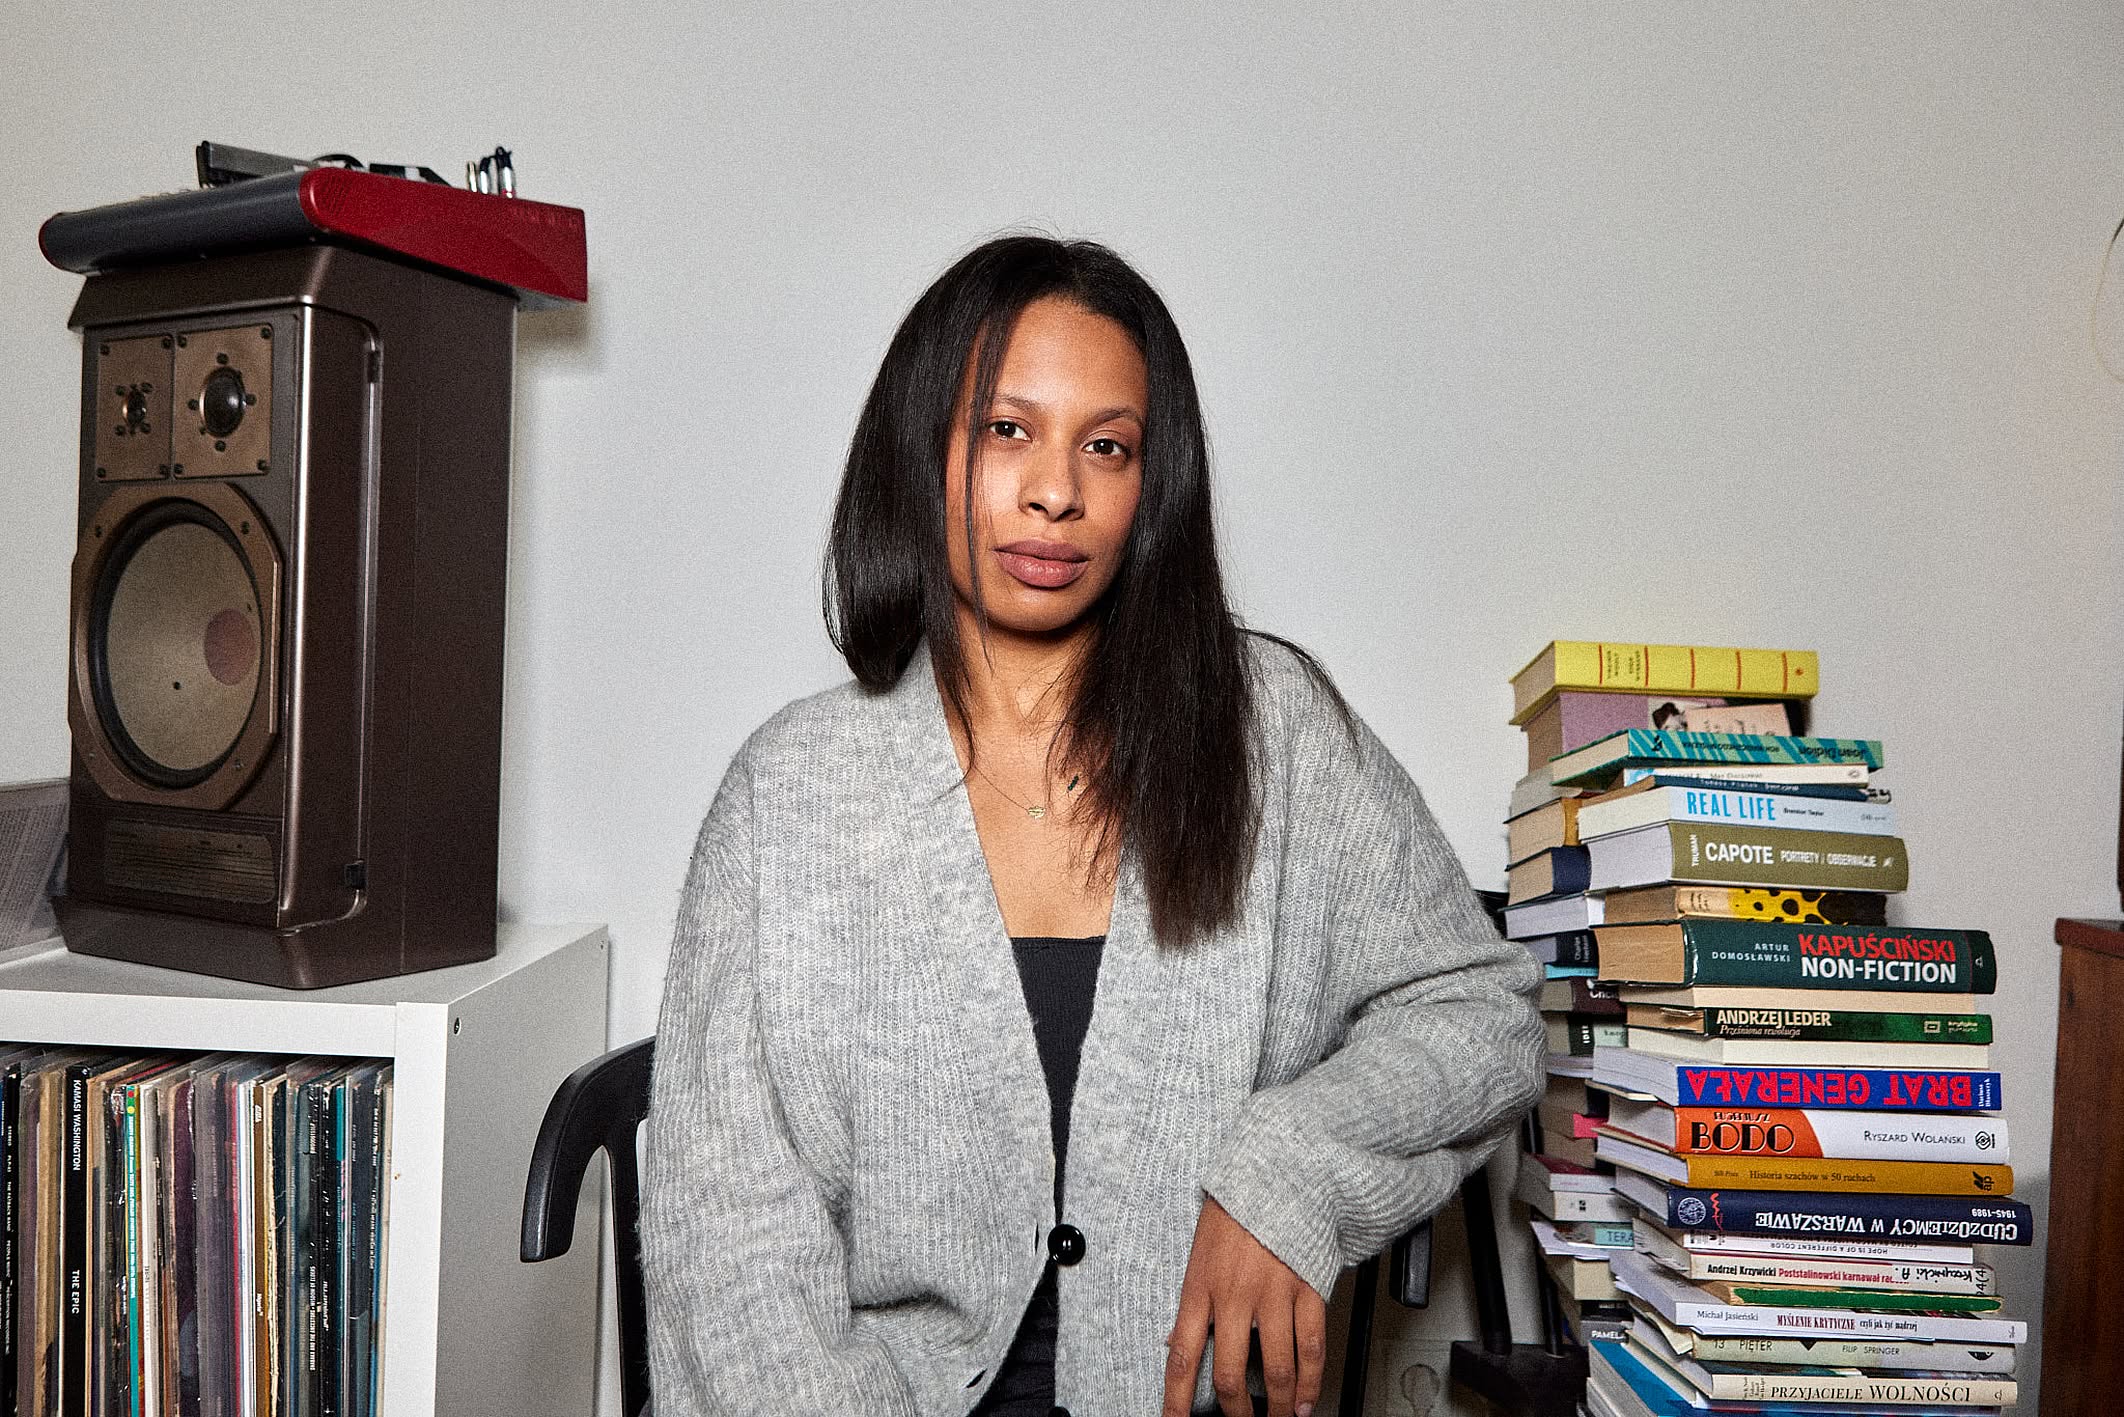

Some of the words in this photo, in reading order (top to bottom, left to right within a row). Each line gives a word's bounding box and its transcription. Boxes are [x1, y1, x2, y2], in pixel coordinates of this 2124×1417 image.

[1686, 791, 1731, 816] REAL
[1739, 796, 1777, 821] LIFE
[1689, 834, 1699, 867] TRUMAN
[1705, 841, 1774, 865] CAPOTE
[1711, 951, 1791, 964] DOMOSŁAWSKI
[1754, 943, 1790, 953] ARTUR
[1798, 933, 1956, 963] KAPUŚCIŃSKI
[1801, 957, 1957, 984] NON-FICTION
[1716, 1010, 1782, 1028] ANDRZEJ
[1784, 1011, 1832, 1027] LEDER
[72, 1079, 82, 1112] KAMASI
[1685, 1069, 1871, 1105] GENERAŁA
[1883, 1073, 1973, 1107] BRAT
[71, 1113, 82, 1171] WASHINGTON
[1690, 1121, 1796, 1153] BODO
[1749, 1170, 1783, 1181] Historia
[1784, 1171, 1820, 1182] szachów
[1821, 1174, 1829, 1182] w
[1831, 1172, 1842, 1182] 50
[1843, 1172, 1877, 1183] ruchach
[1755, 1211, 1866, 1233] WARSZAWIE
[1889, 1219, 2018, 1242] CUDZOZIEMCY
[1846, 1246, 1856, 1254] OF
[1867, 1247, 1888, 1256] HOPE
[70, 1269, 80, 1289] THE
[1707, 1263, 1737, 1276] Andrzej
[1739, 1265, 1777, 1279] Krzywicki
[1778, 1269, 1842, 1283] Poststalinowski
[1842, 1272, 1882, 1284] karnawał
[70, 1291, 80, 1314] EPIC
[1696, 1309, 1724, 1320] Michał
[1724, 1311, 1759, 1324] Jasieński
[1777, 1312, 1812, 1330] MYŚLENIE
[1814, 1314, 1855, 1331] KRYTYCZNE
[1873, 1319, 1883, 1330] jak
[1713, 1339, 1725, 1350] 13
[1842, 1344, 1858, 1354] FILIP
[1863, 1345, 1901, 1356] SPRINGER
[1770, 1385, 1863, 1401] PRZYJACIELE
[1869, 1382, 1971, 1403] WOLNOŚCI
